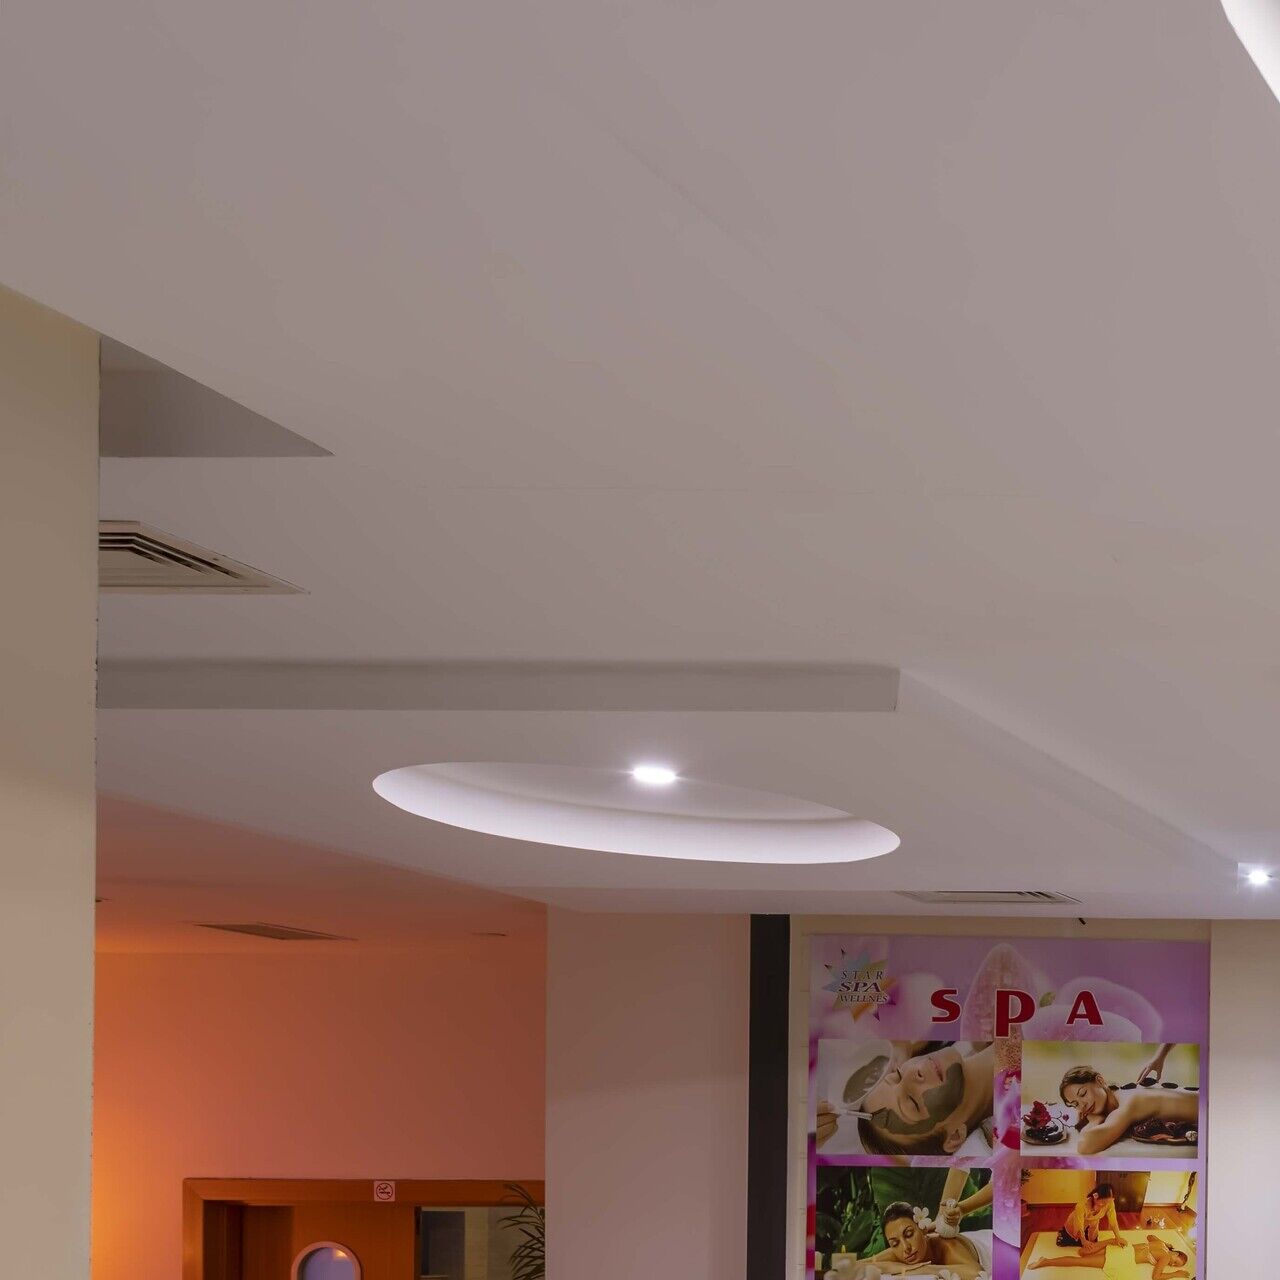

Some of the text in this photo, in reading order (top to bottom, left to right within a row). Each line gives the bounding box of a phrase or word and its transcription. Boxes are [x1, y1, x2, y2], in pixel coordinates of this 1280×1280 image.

[840, 970, 884, 980] STAR
[838, 981, 881, 993] SPA
[839, 994, 889, 1004] WELLNES
